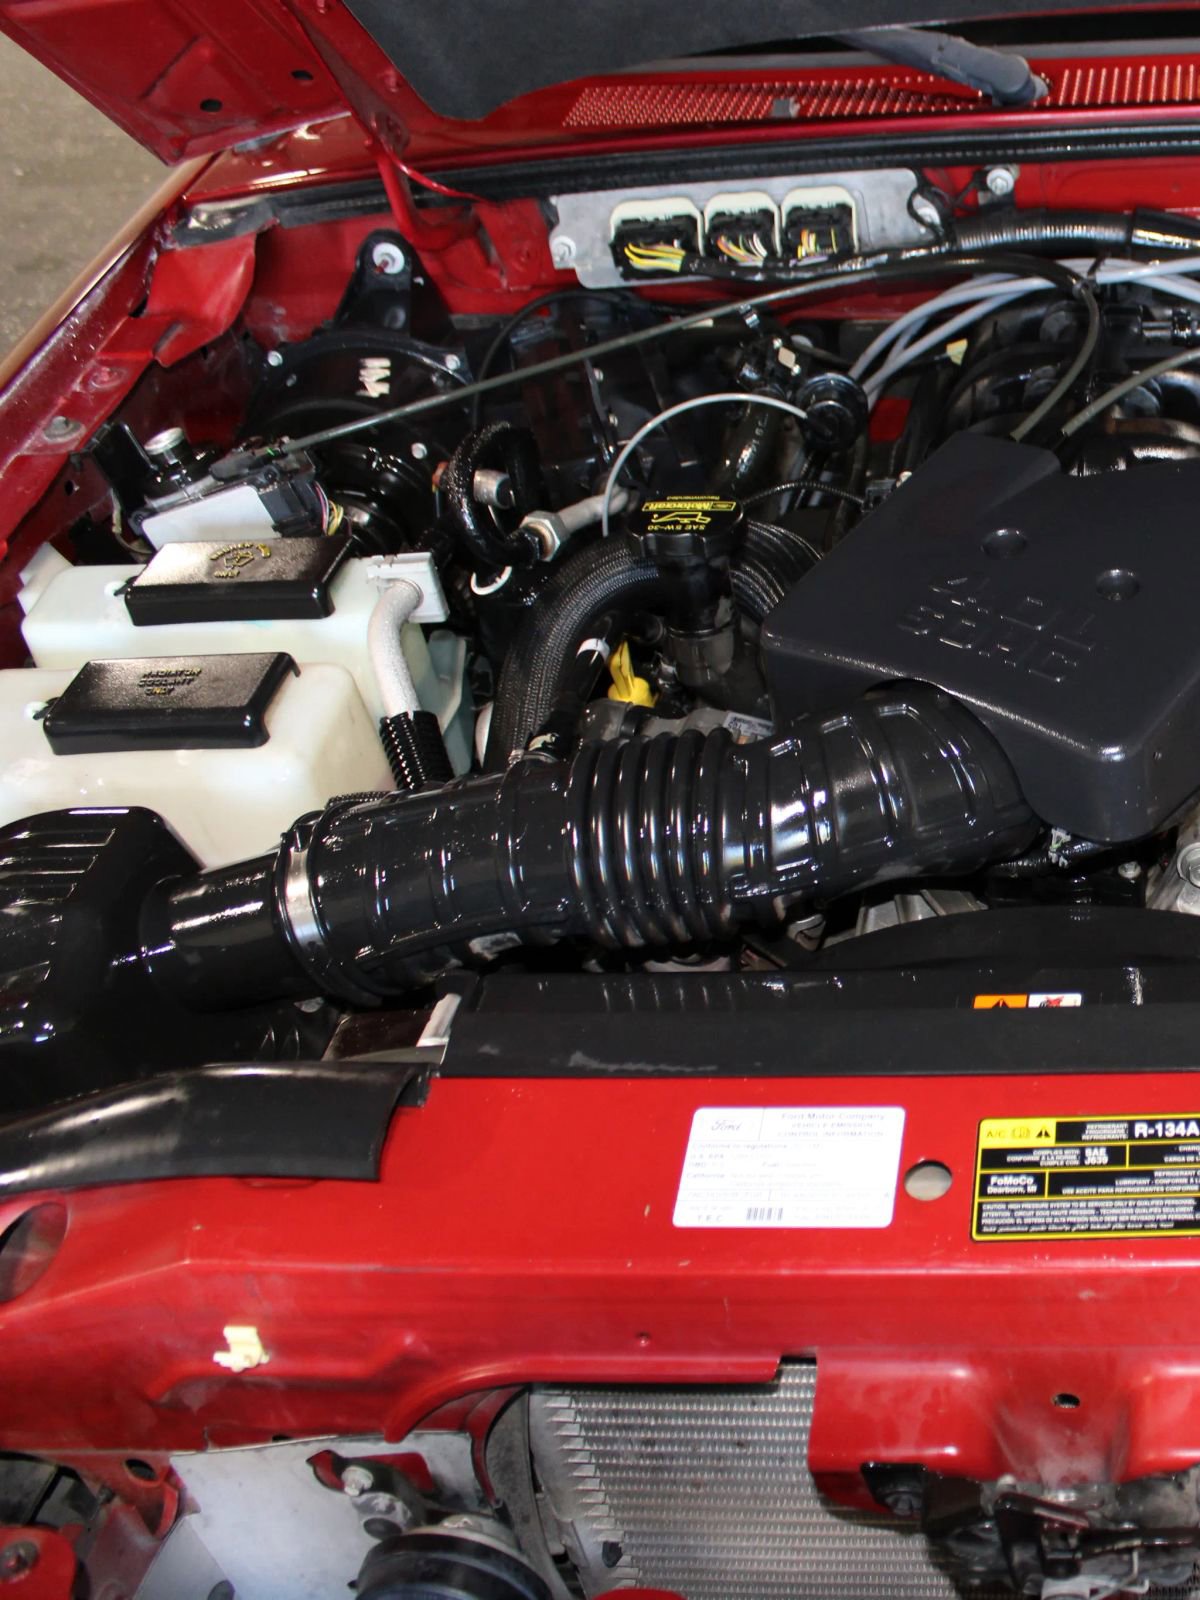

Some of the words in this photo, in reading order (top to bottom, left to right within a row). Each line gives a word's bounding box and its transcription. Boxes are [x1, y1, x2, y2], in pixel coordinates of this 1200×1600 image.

[649, 501, 711, 510] Motorcraft
[896, 605, 1077, 683] SOHC
[711, 1119, 743, 1132] Ford
[1134, 1120, 1200, 1139] R-134A
[986, 1129, 1005, 1139] A/C
[1085, 1147, 1107, 1156] SAE
[1084, 1156, 1109, 1165] J639
[990, 1175, 1035, 1186] FoMoCo
[987, 1186, 1026, 1196] Dearborn,
[1027, 1185, 1038, 1194] MI
